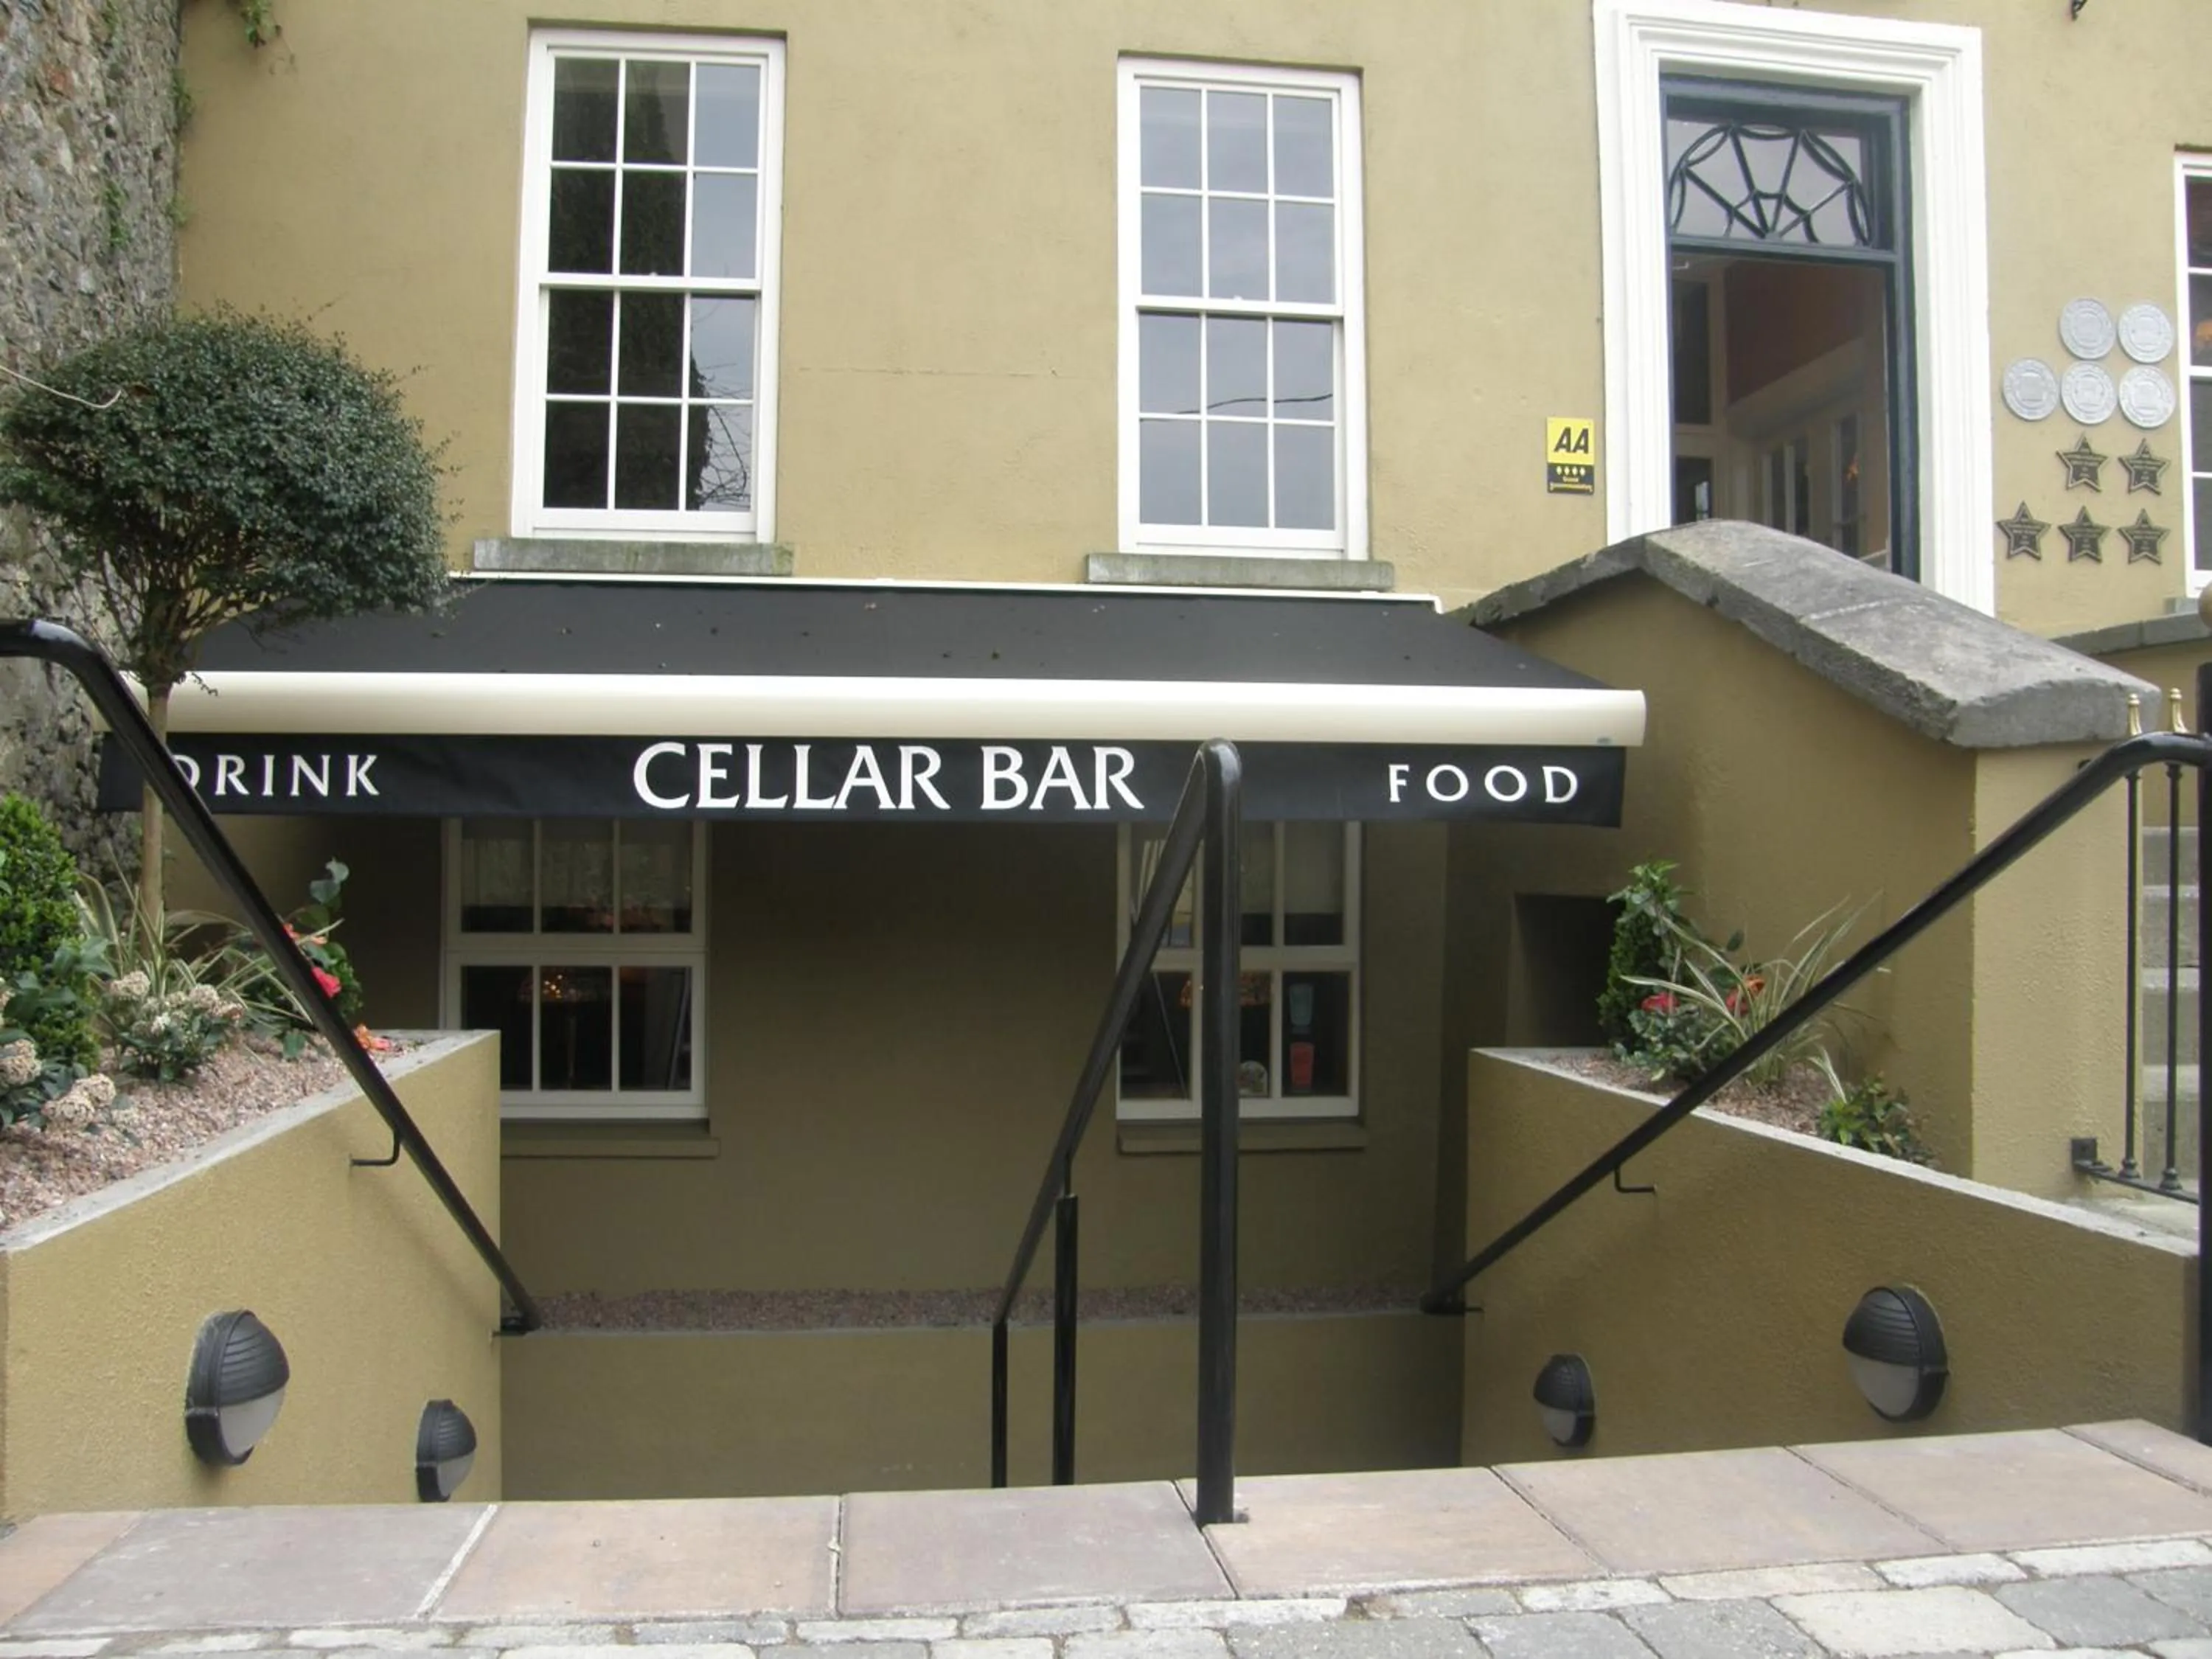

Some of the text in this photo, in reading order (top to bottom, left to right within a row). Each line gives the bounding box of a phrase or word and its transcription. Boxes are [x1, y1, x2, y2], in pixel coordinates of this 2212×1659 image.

[1554, 426, 1589, 454] AA
[633, 742, 1145, 811] CELLAR BAR
[1388, 764, 1579, 804] FOOD
